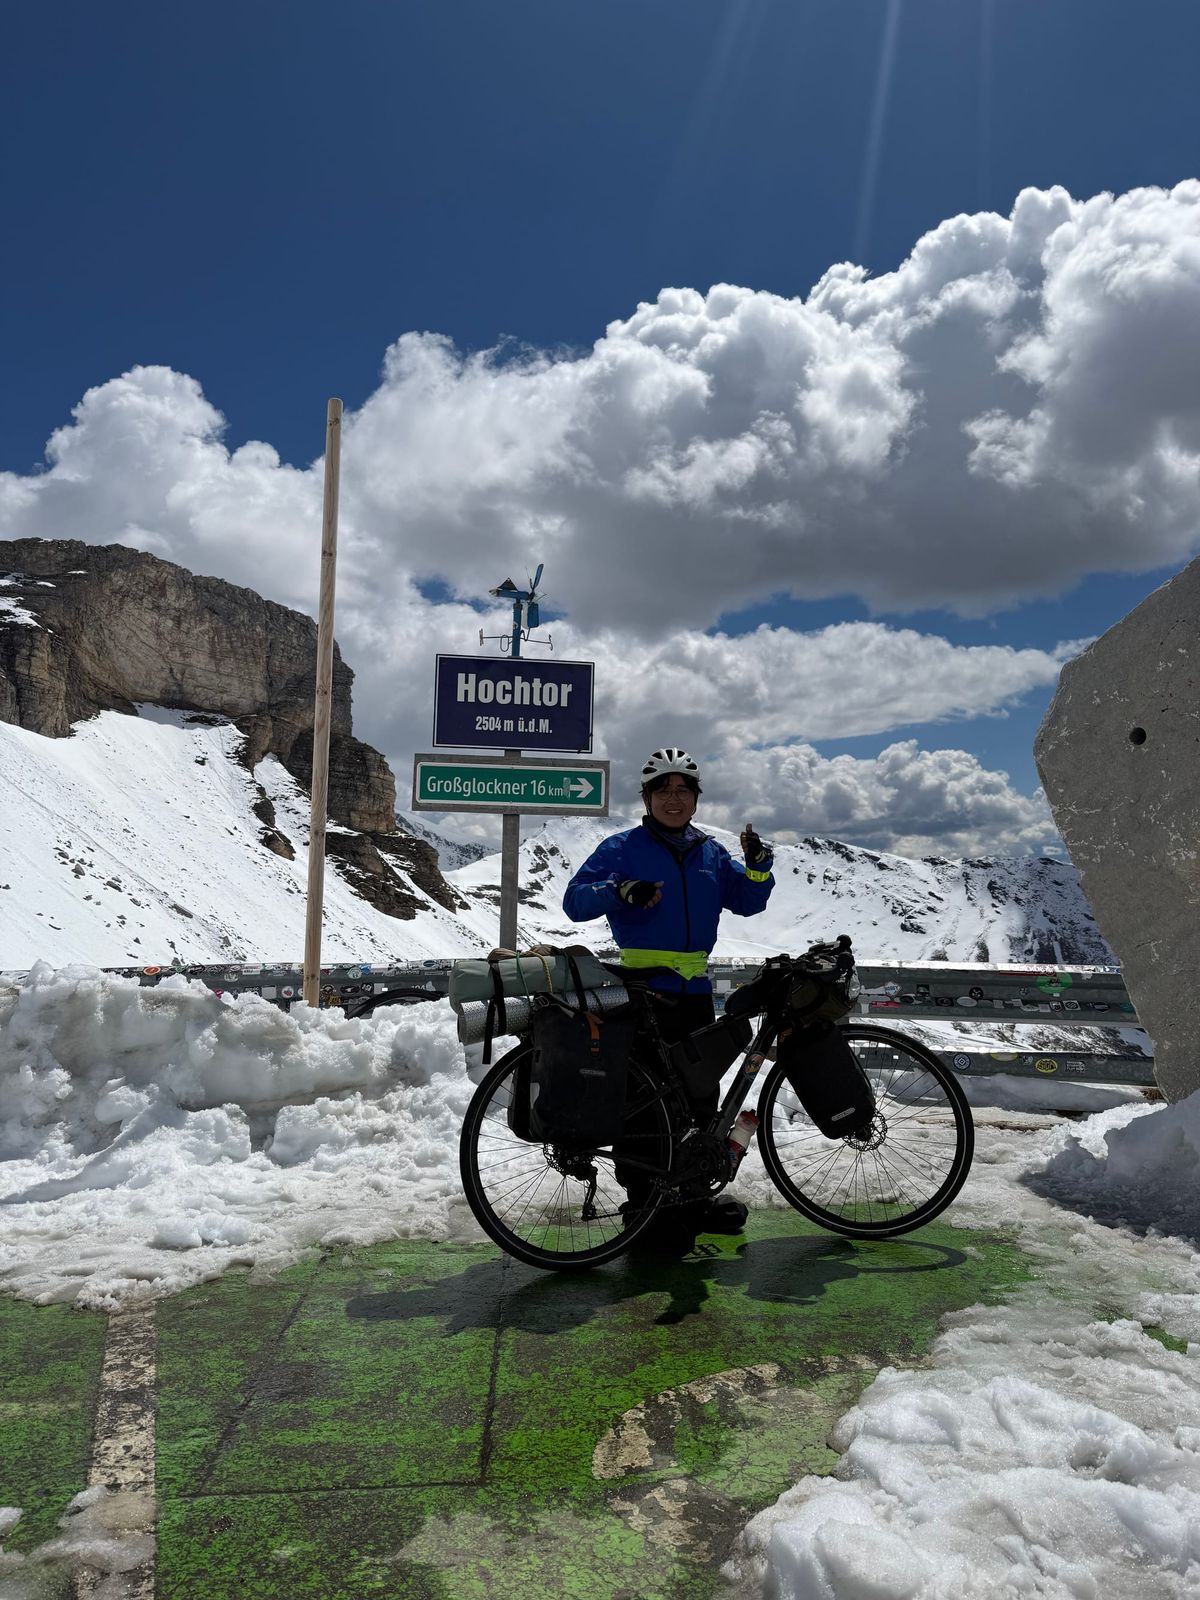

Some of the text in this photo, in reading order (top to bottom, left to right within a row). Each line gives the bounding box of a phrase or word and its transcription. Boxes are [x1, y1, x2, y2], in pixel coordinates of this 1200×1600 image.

[456, 672, 572, 707] Hochtor
[475, 716, 553, 734] 2504 m ü.d.M.
[427, 775, 564, 797] Großglockner 16 km
